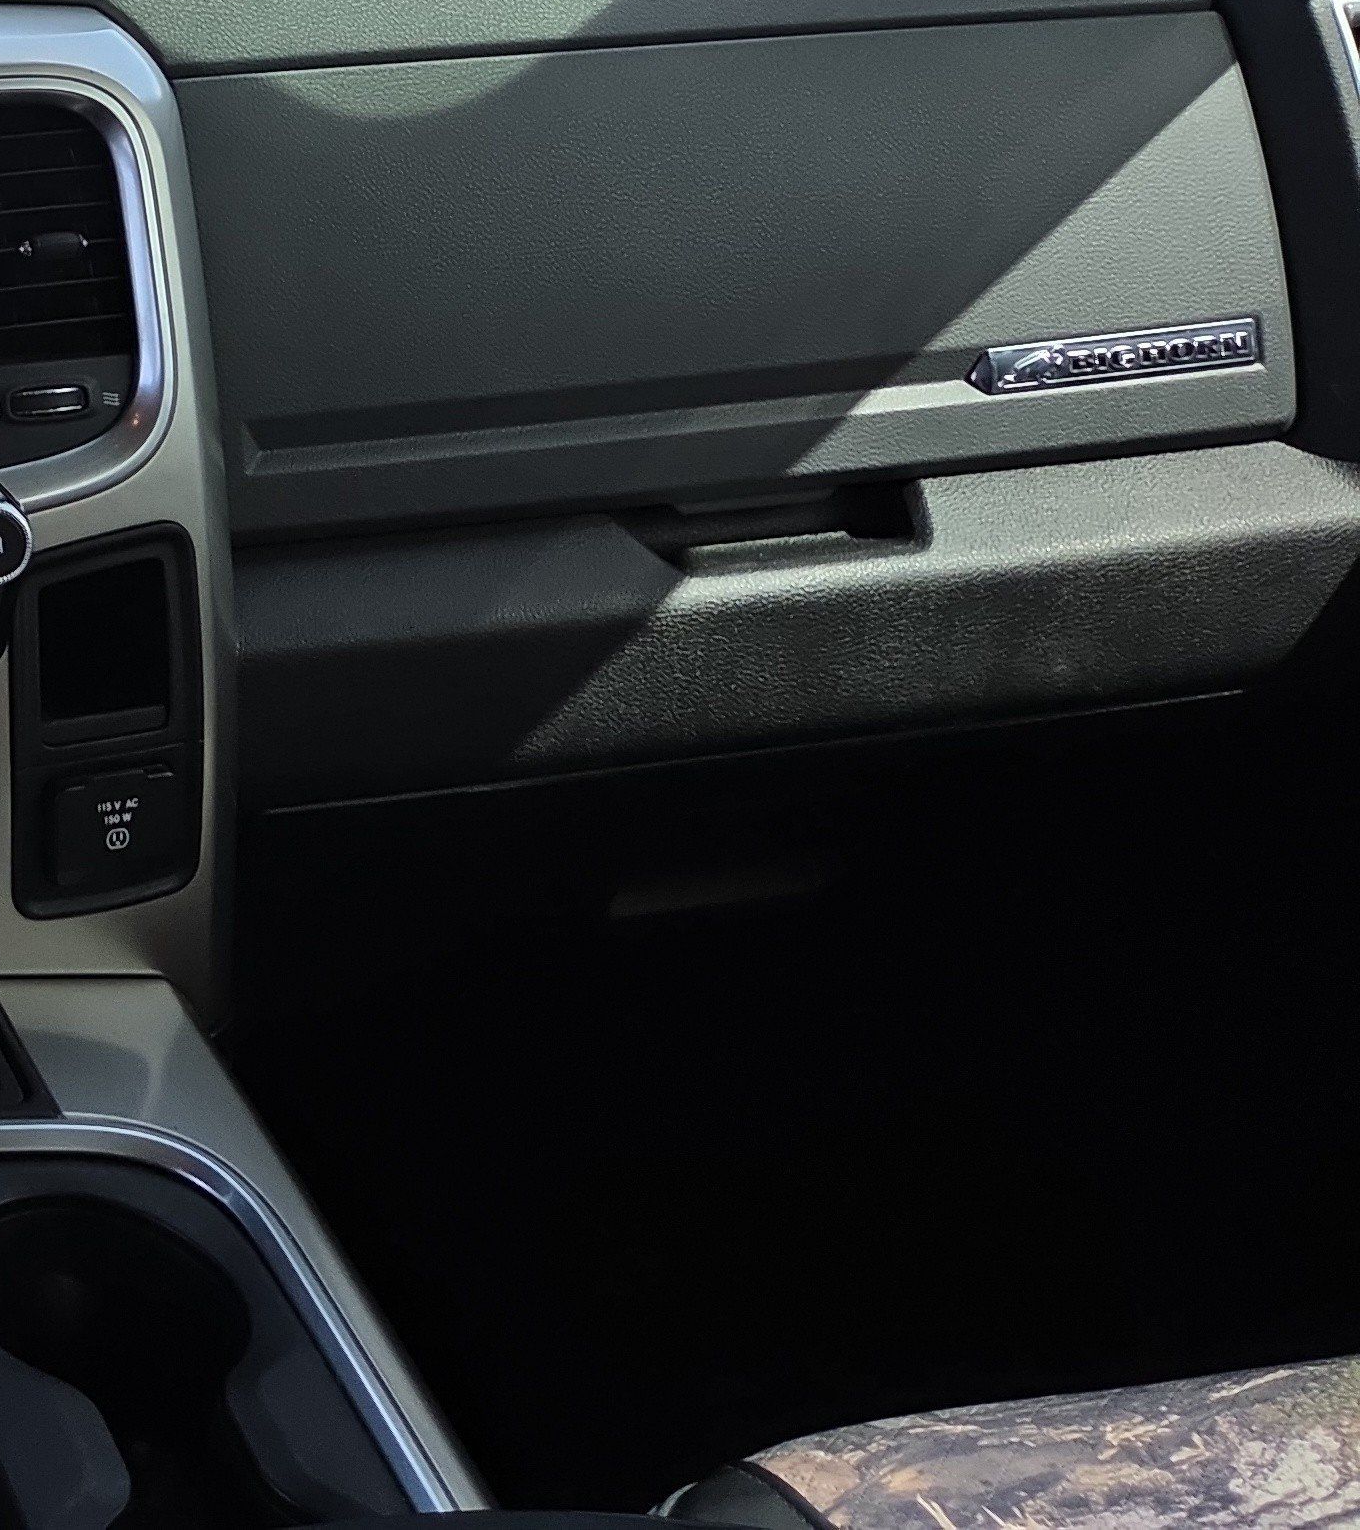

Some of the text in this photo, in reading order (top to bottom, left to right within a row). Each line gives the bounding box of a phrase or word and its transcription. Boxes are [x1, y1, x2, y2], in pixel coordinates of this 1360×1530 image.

[97, 797, 139, 813] 115 V AC
[104, 811, 133, 825] 150 W
